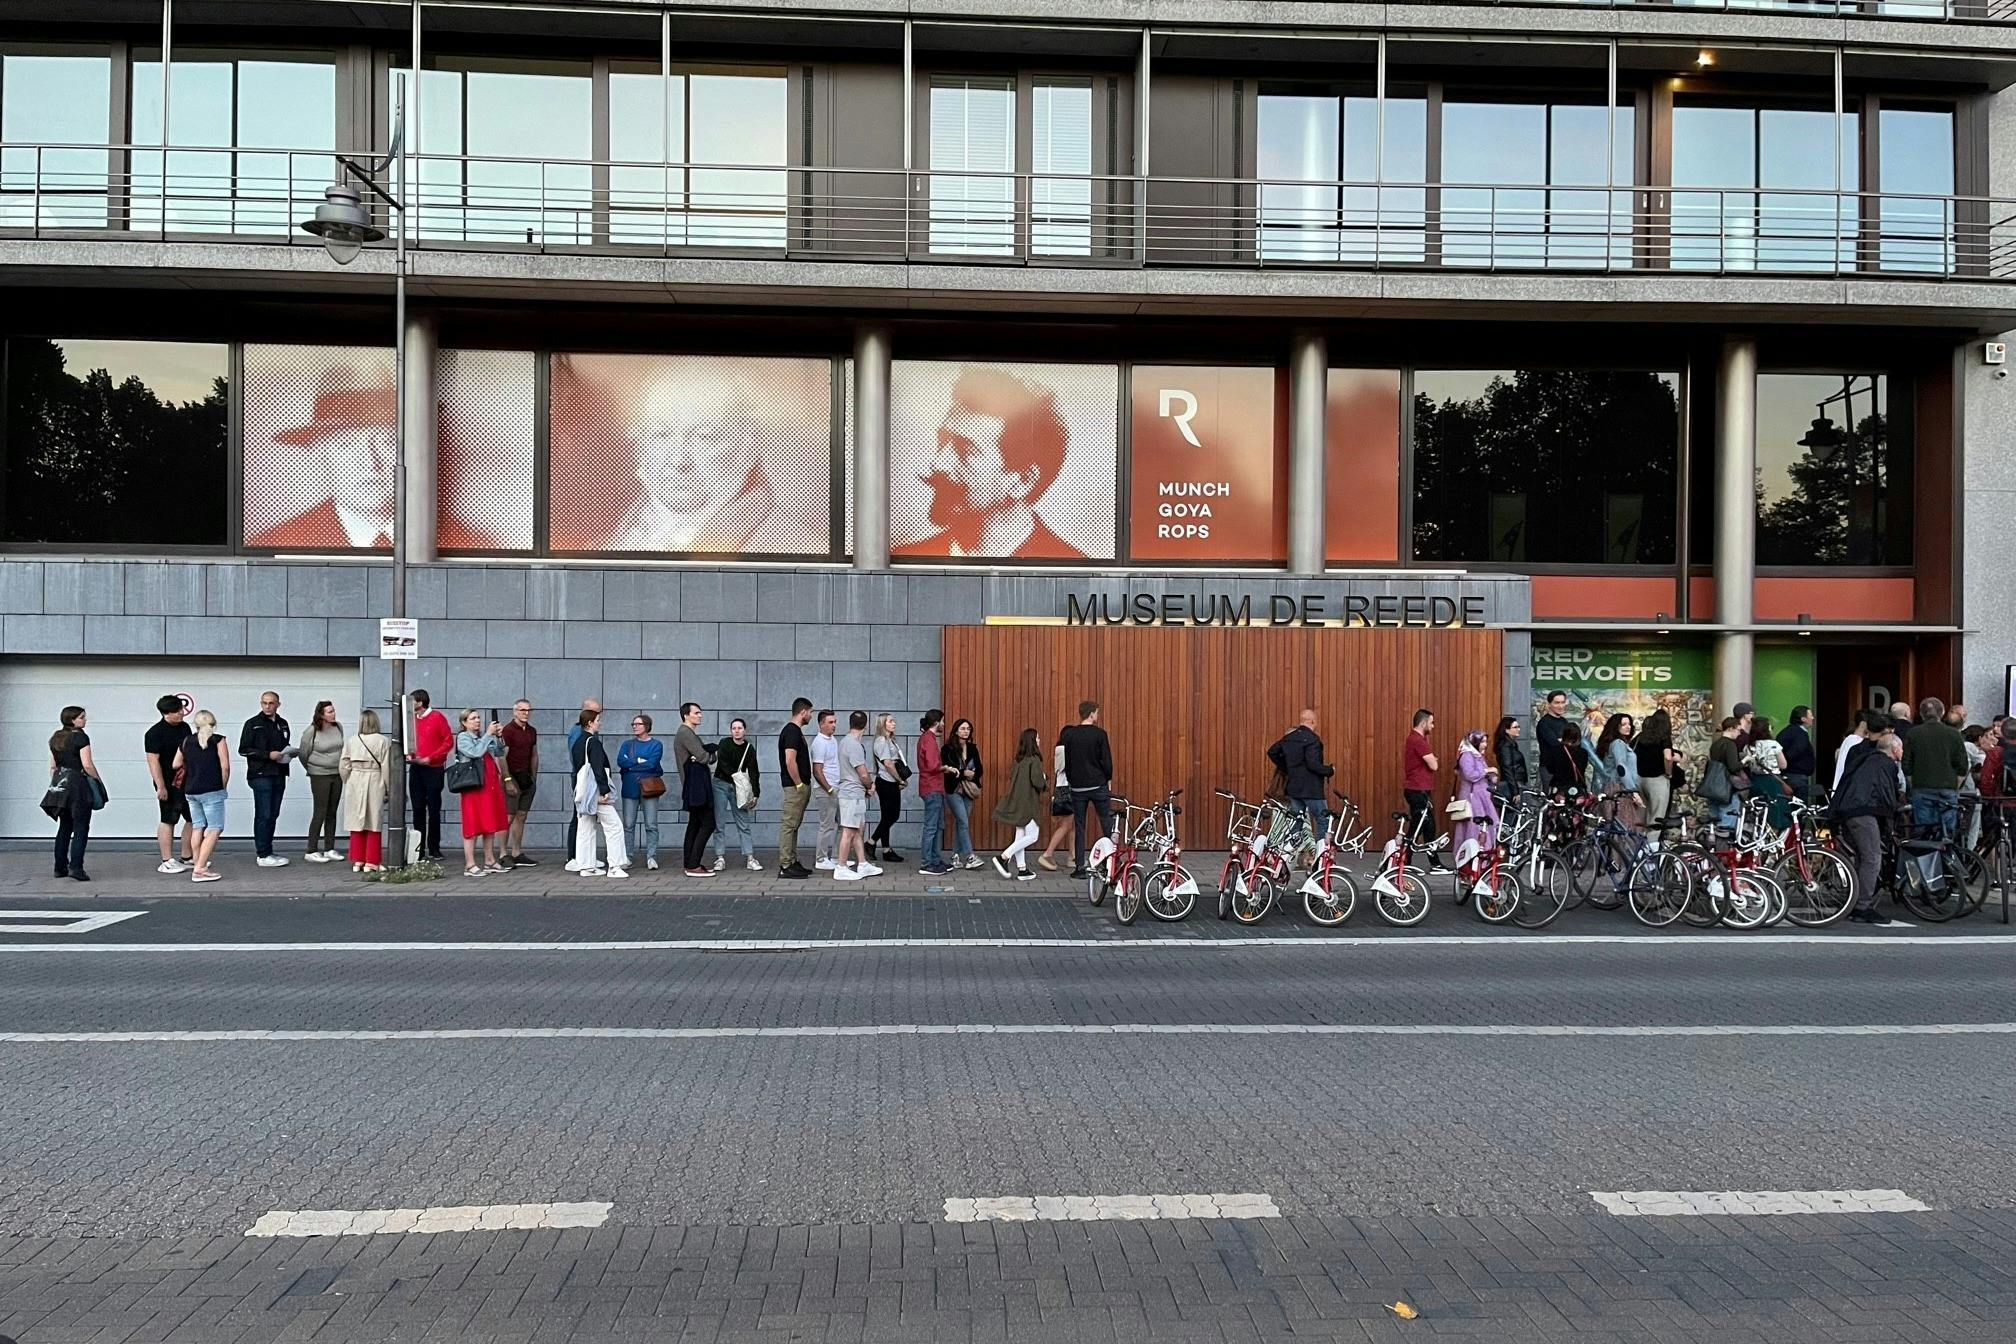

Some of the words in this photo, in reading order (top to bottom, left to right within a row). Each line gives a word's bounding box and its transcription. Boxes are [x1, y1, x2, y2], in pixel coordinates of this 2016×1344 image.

[1159, 389, 1202, 447] R
[1159, 482, 1230, 497] MUNCH
[1158, 503, 1212, 518] GOYA
[1158, 524, 1209, 539] ROPS
[1067, 593, 1251, 627] MUSEUM
[1269, 594, 1325, 628] DE
[1343, 595, 1486, 628] REEDE
[1531, 647, 1594, 663] RED
